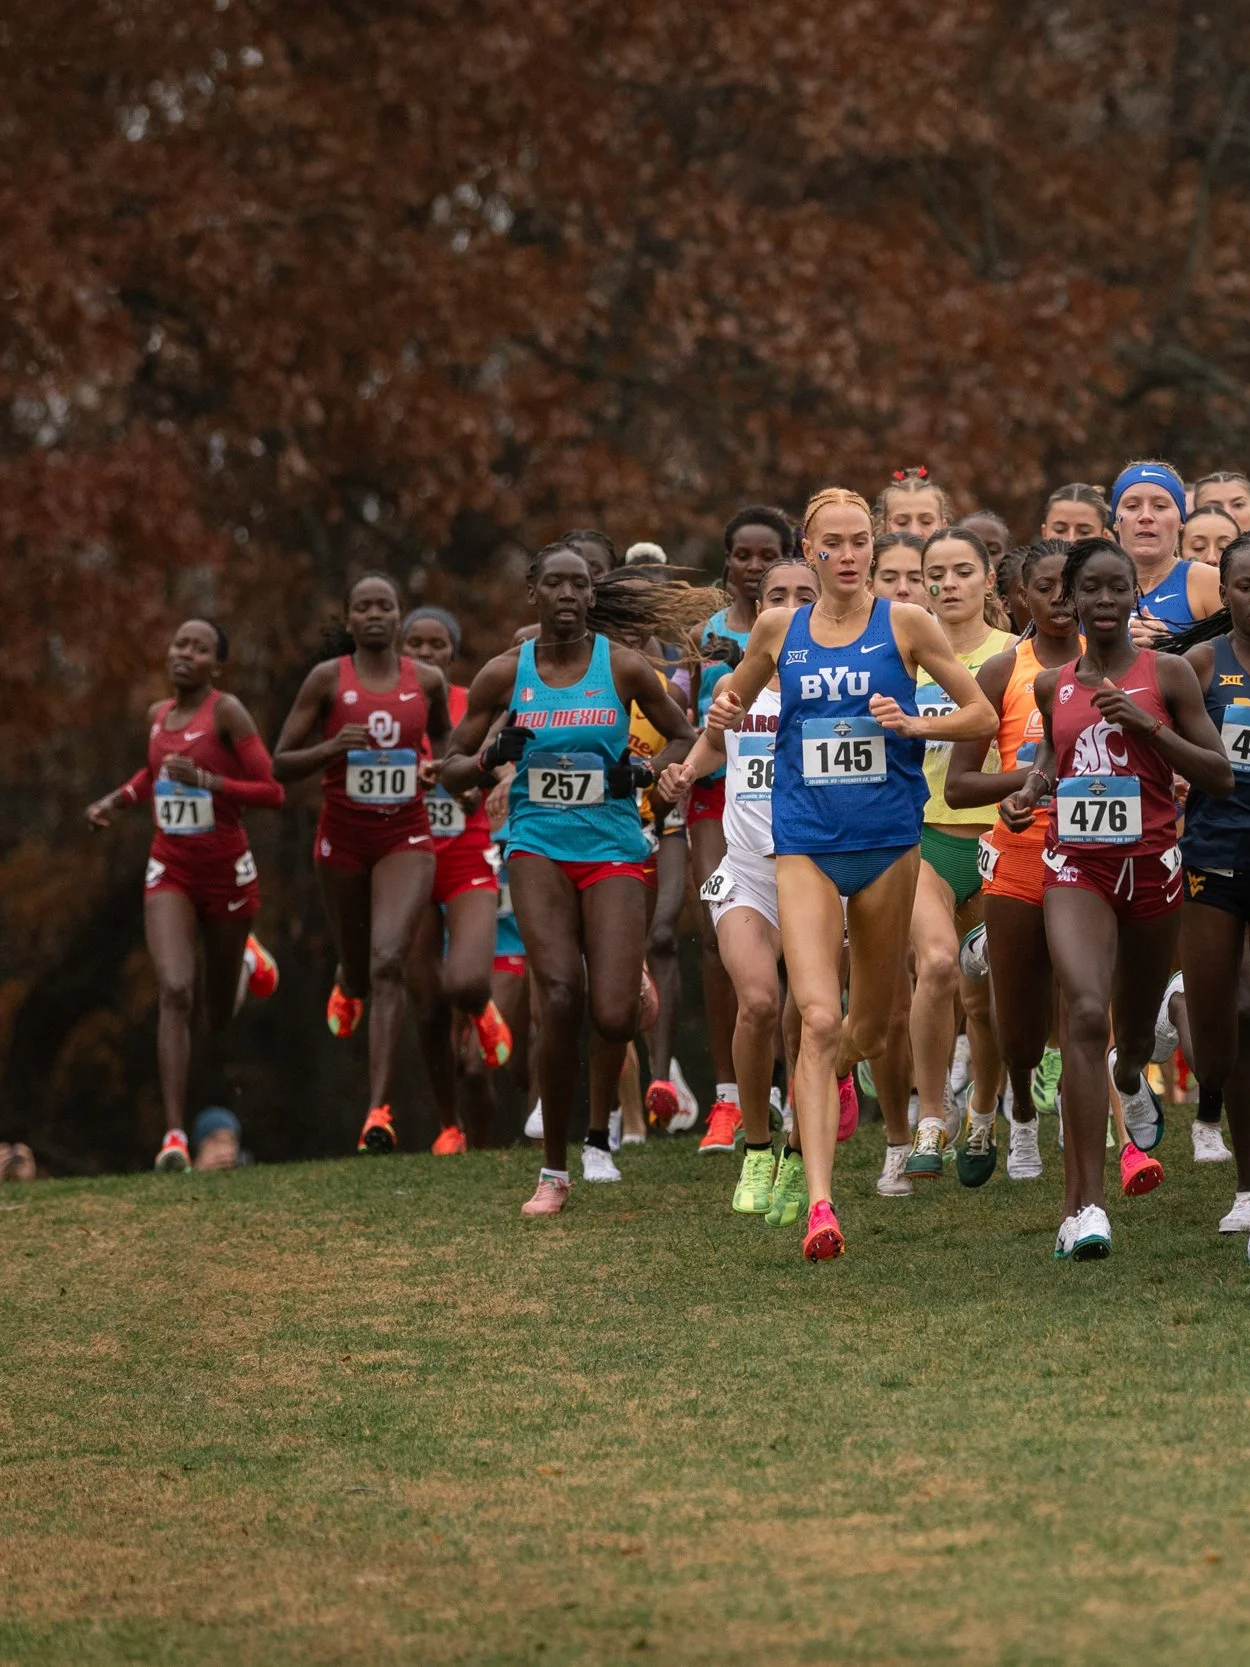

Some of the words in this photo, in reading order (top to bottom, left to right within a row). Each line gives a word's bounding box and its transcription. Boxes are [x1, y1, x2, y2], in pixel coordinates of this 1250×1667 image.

[800, 666, 870, 701] BYU
[368, 710, 400, 748] OU
[550, 708, 618, 728] MEXICO
[816, 741, 872, 773] 145
[359, 769, 405, 794] 310
[541, 772, 591, 801] 257
[161, 800, 198, 825] 471
[1070, 800, 1127, 832] 476
